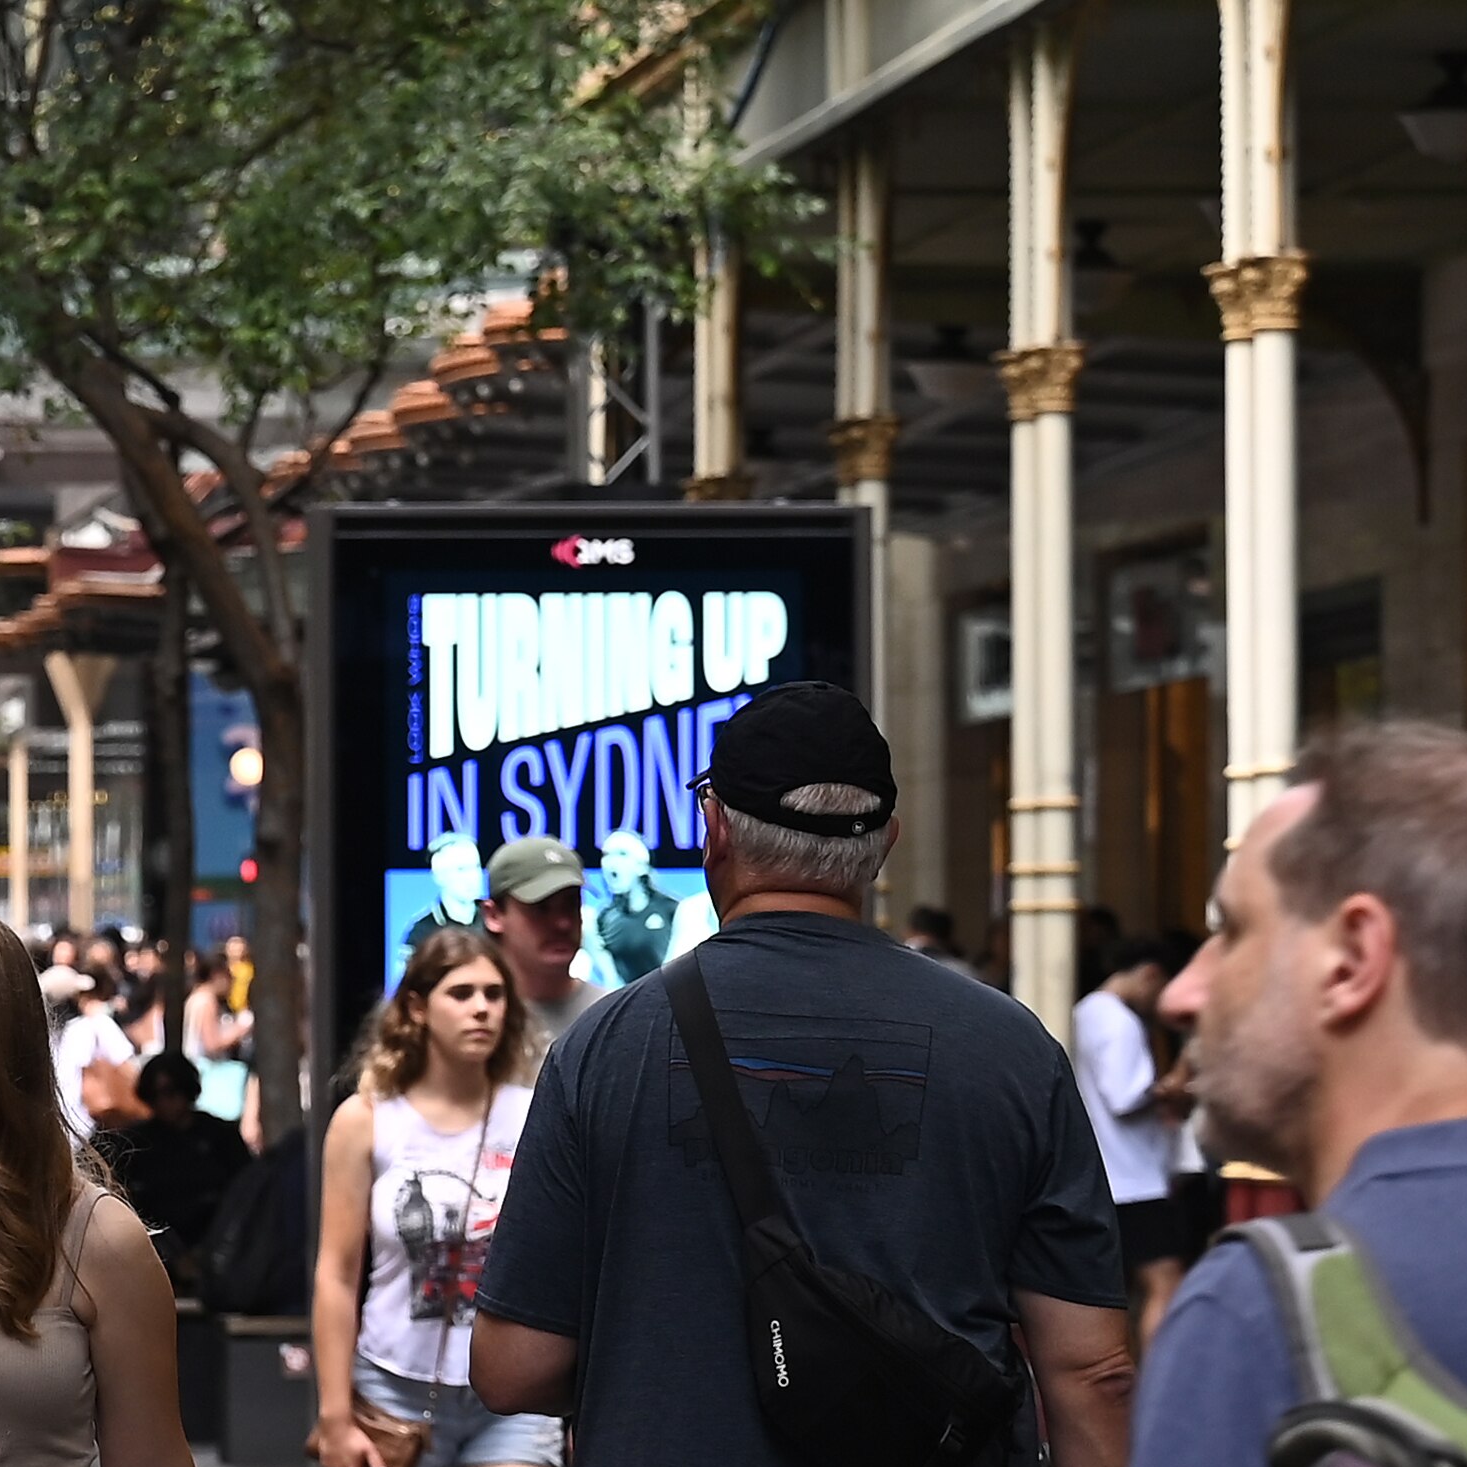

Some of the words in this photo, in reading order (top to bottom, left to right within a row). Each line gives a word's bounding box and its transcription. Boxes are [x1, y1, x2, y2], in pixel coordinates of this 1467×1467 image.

[422, 590, 694, 759] TURNING
[702, 591, 788, 693] UP
[407, 691, 424, 764] LOOK
[407, 759, 478, 850] IN
[770, 1319, 790, 1388] CHIMOMO
